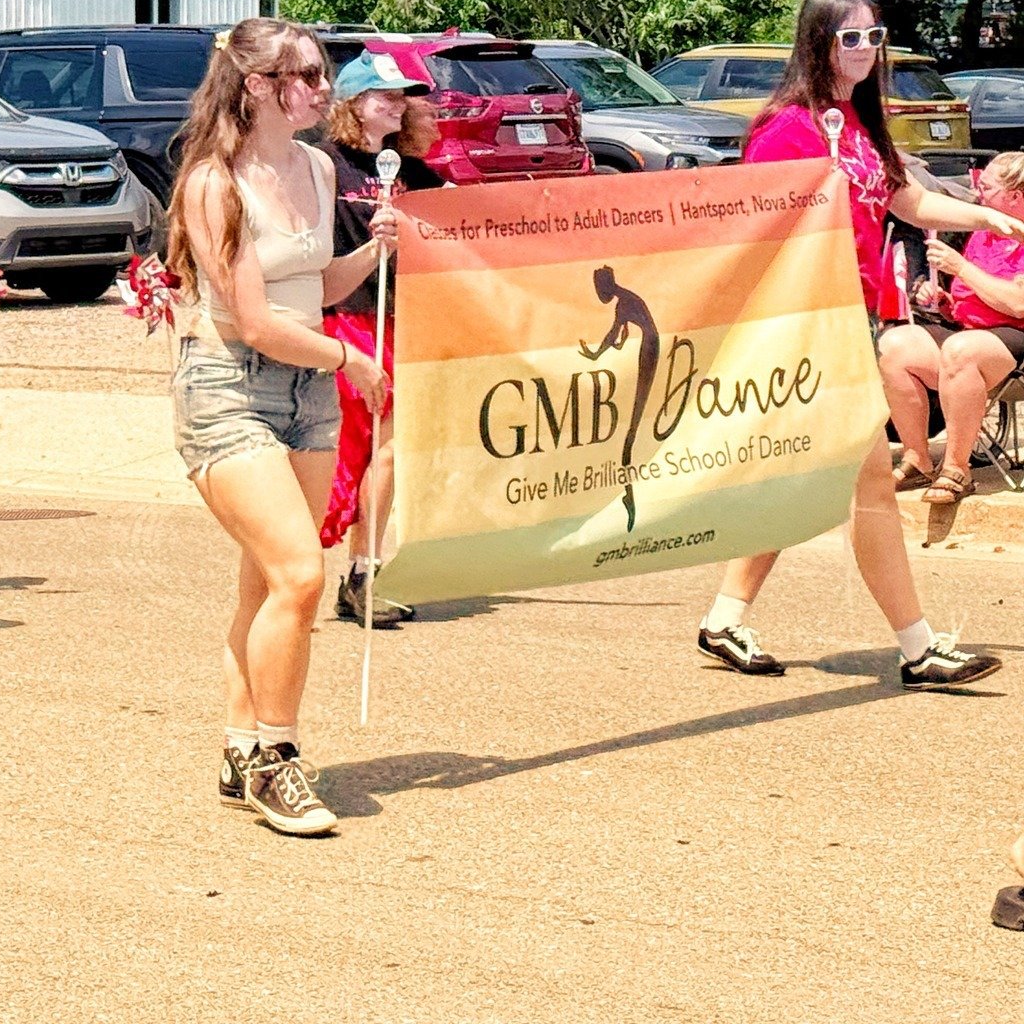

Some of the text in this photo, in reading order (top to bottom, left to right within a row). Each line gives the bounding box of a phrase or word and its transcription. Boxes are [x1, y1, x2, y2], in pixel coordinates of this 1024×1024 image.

[461, 218, 482, 240] for
[485, 212, 551, 239] Preschool
[555, 215, 569, 233] to
[574, 208, 608, 231] Adult
[611, 207, 664, 227] Dancers
[680, 197, 750, 222] Hantsport,
[751, 194, 787, 214] Nova
[789, 190, 829, 209] Scotia
[479, 335, 822, 460] GMB Dance
[506, 432, 812, 505] Give Me Brilliance School of Dance
[593, 529, 715, 568] gmbrilliance.com
